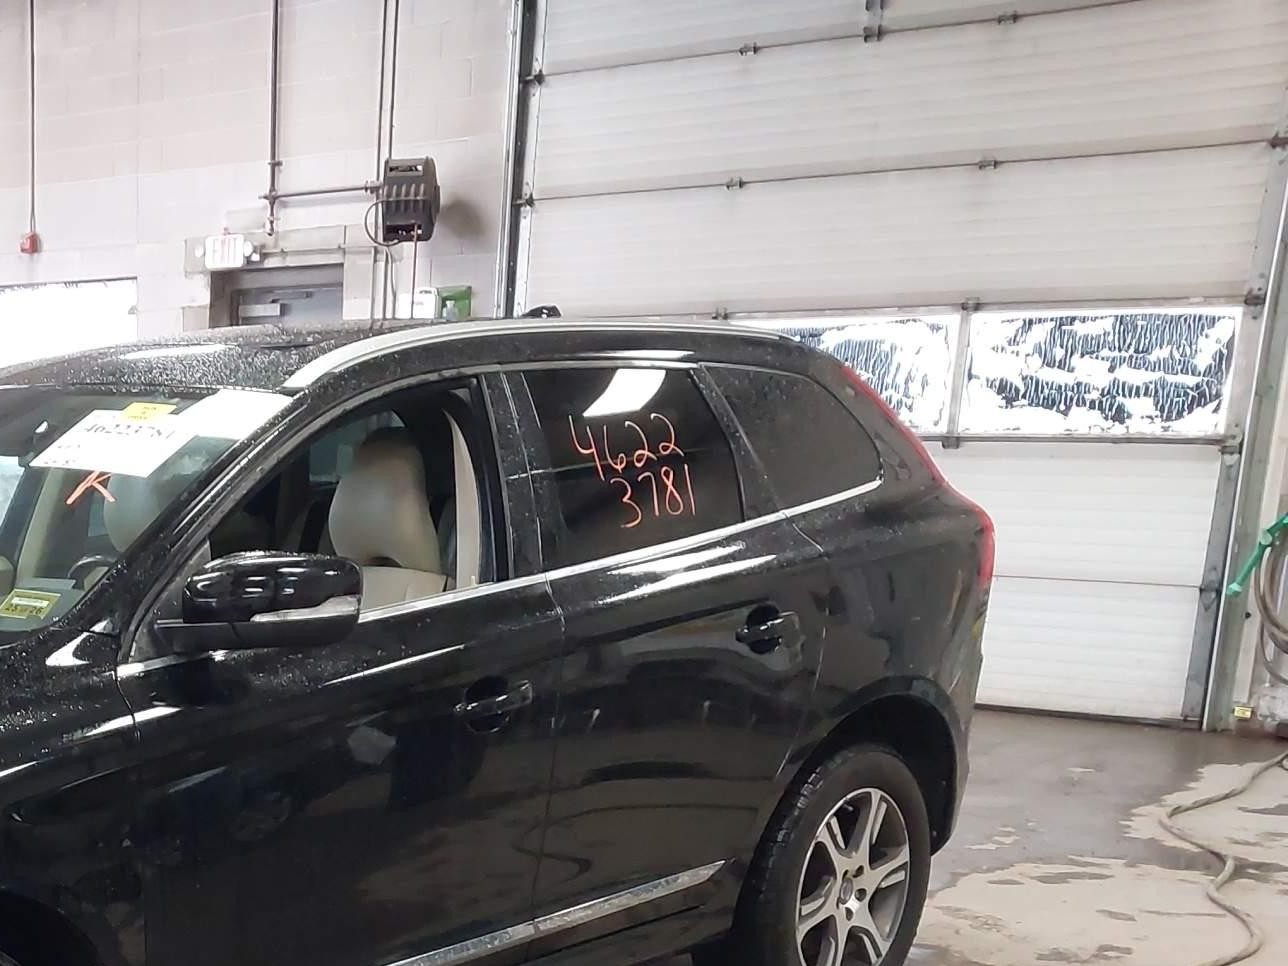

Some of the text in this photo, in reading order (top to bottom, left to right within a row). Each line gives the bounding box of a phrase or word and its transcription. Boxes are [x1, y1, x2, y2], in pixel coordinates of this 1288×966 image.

[212, 237, 239, 264] EXIT
[568, 413, 685, 481] 4622
[610, 464, 696, 528] 3781
